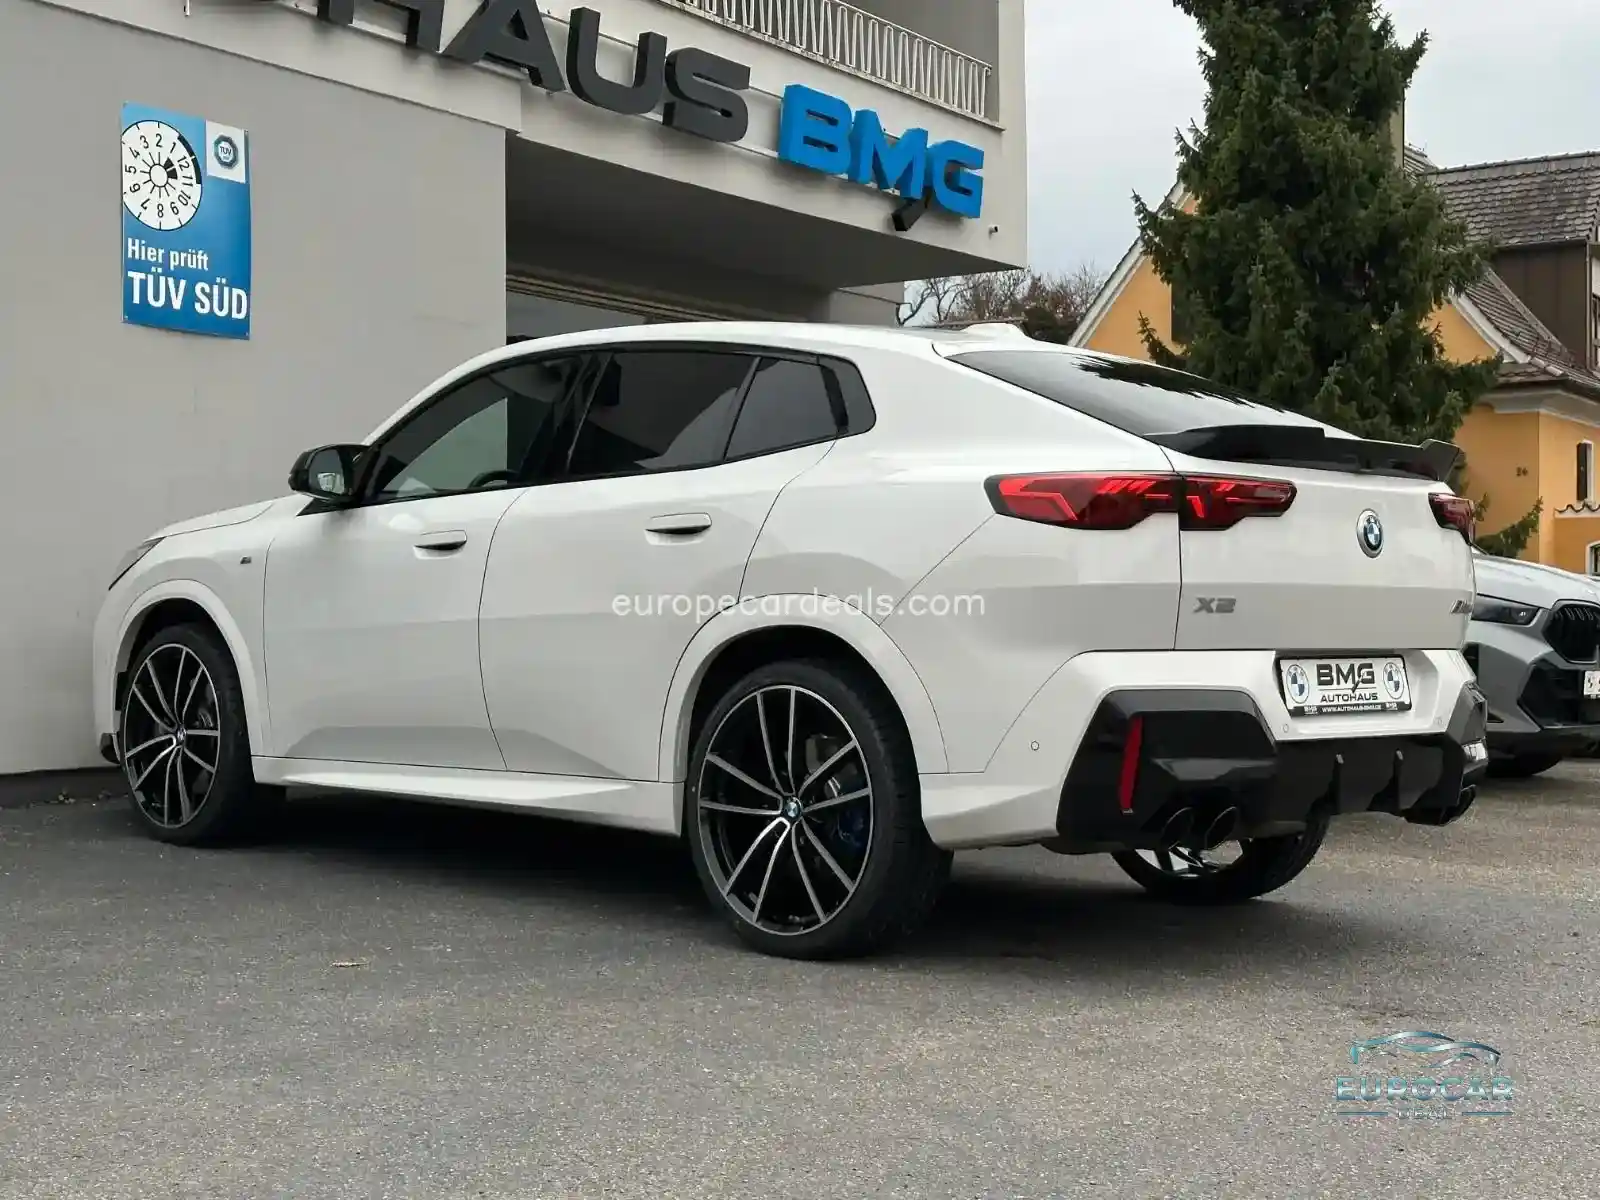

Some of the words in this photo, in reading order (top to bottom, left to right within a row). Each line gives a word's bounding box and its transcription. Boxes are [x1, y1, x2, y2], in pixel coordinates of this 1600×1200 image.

[139, 135, 149, 149] 3
[156, 133, 163, 148] 2
[169, 142, 177, 154] 1
[128, 146, 141, 159] 4
[779, 84, 984, 230] BMG
[124, 164, 137, 175] 5
[176, 156, 190, 171] 12
[181, 175, 194, 187] 11
[177, 190, 192, 207] 10
[156, 203, 164, 218] 8
[127, 237, 165, 263] Hier
[169, 249, 209, 271] prüft
[127, 267, 187, 311] TÜV
[194, 277, 248, 320] SÜD
[1316, 662, 1376, 694] BMG
[1320, 693, 1378, 703] AUTOHAUS
